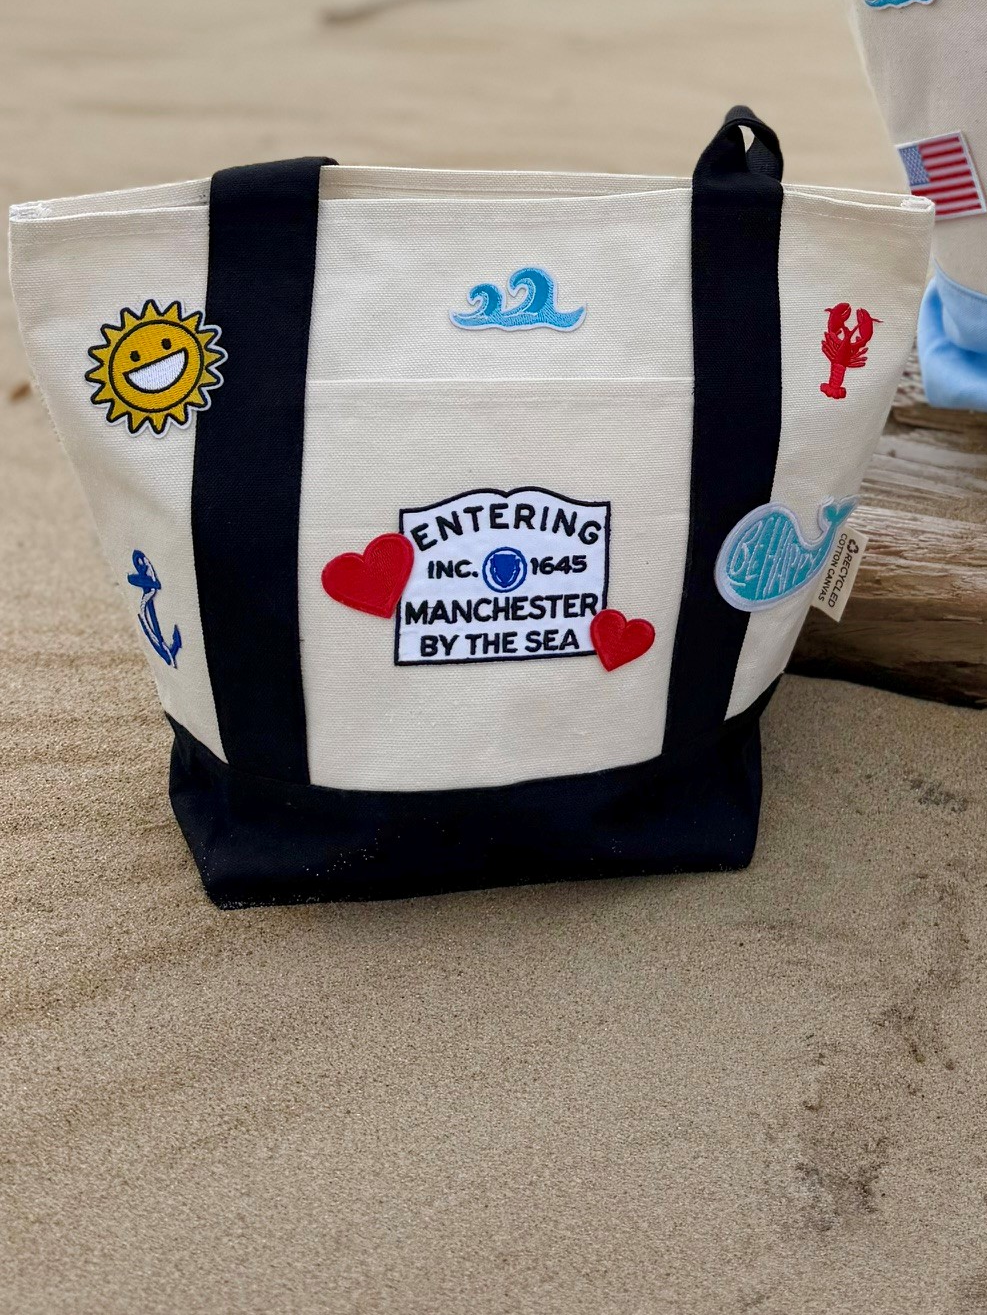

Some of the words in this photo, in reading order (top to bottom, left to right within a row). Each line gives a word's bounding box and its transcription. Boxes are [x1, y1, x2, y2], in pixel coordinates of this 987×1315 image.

[409, 502, 602, 552] ENTERING
[427, 559, 479, 580] INC.
[530, 554, 588, 576] 1645
[830, 533, 848, 568] COTTON
[818, 568, 835, 602] CANVAS
[827, 552, 853, 608] RECYCLED
[404, 592, 599, 625] MANCHESTER
[420, 634, 460, 658] BY
[465, 631, 518, 656] THE
[525, 628, 580, 653] SEA
